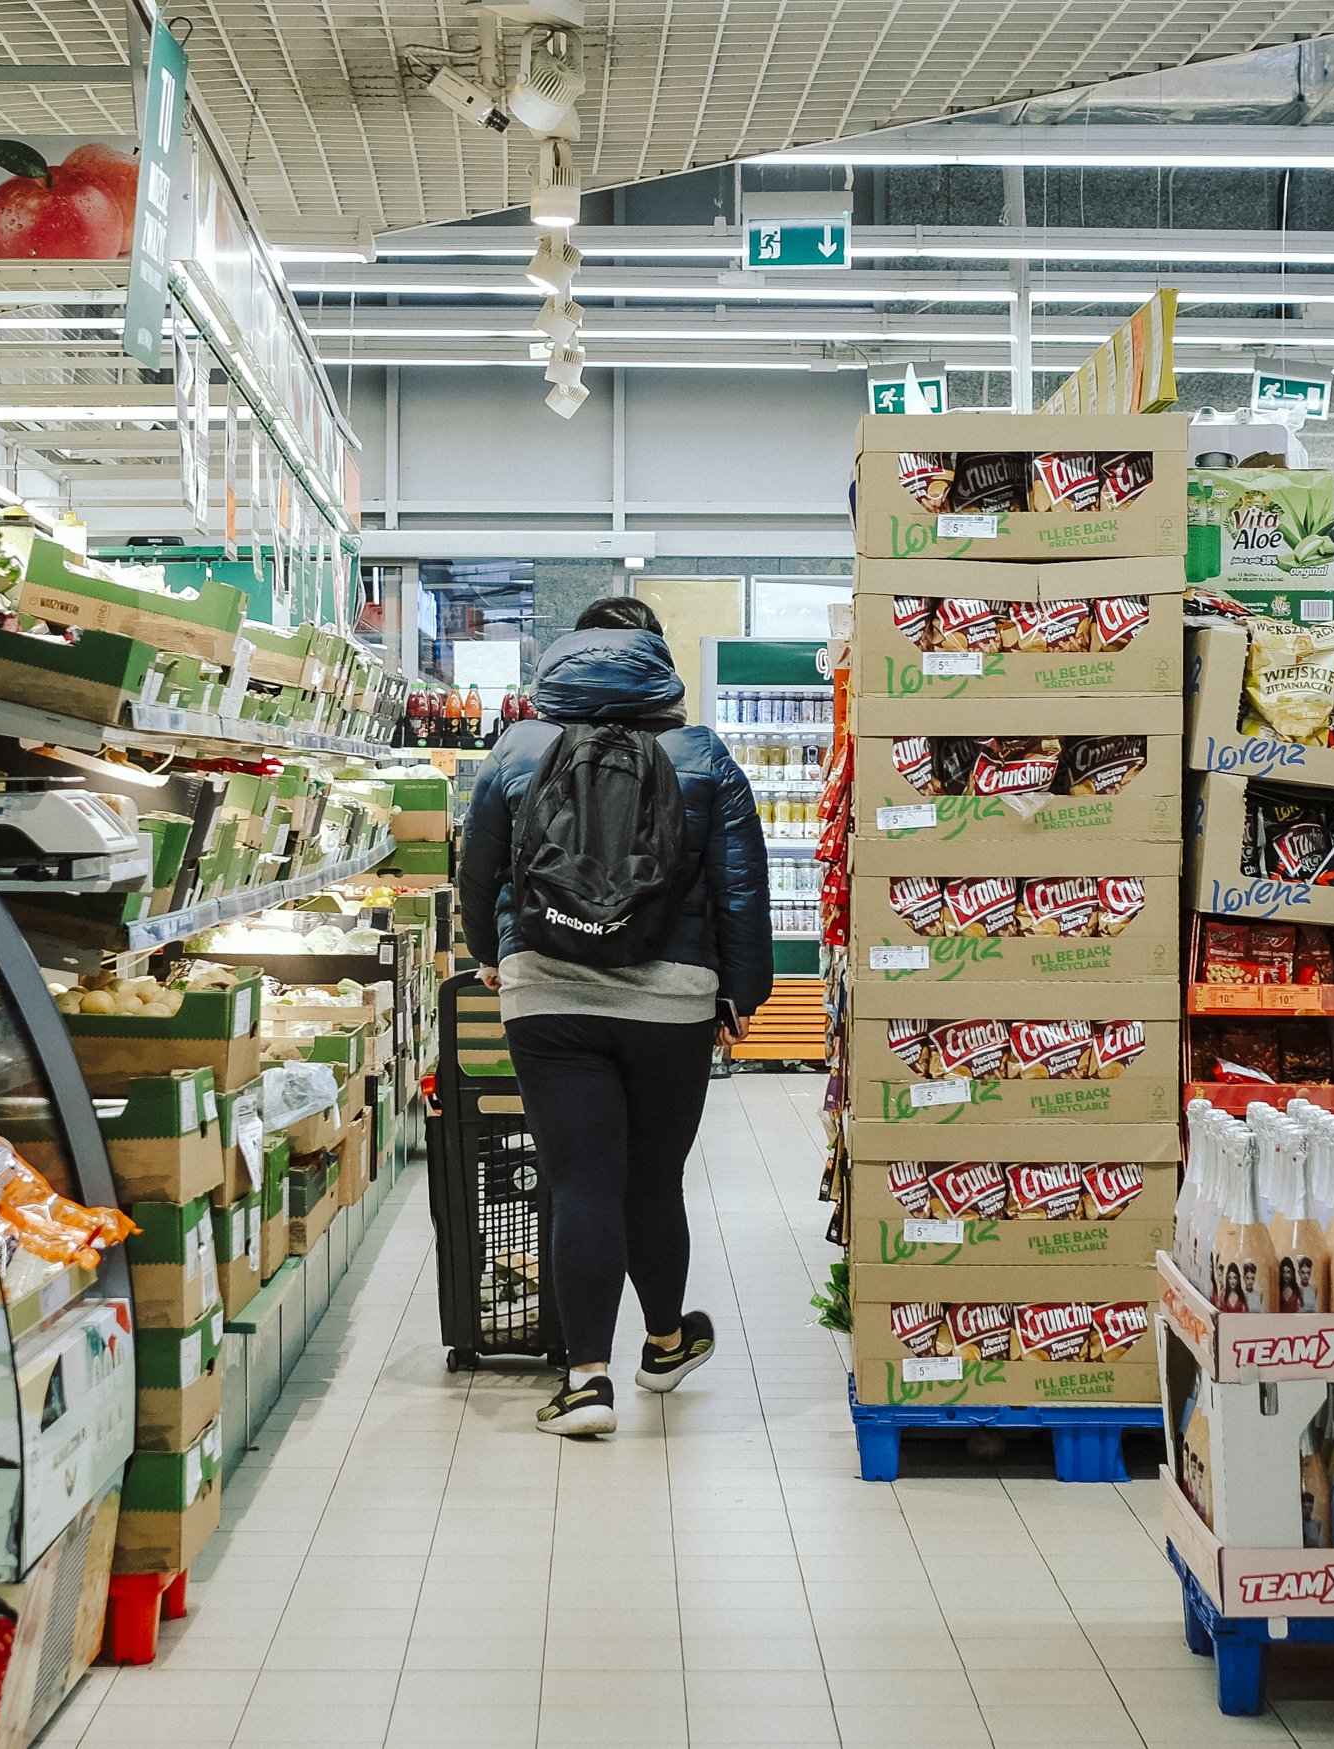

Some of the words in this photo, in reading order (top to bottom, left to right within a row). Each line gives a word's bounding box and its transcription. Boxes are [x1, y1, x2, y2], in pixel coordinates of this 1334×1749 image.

[158, 67, 175, 154] TU
[1233, 508, 1280, 530] Vita
[1039, 527, 1061, 542] I'LL
[1063, 525, 1083, 538] BE
[1084, 519, 1119, 535] BACK
[1049, 533, 1117, 548] #RECYCLABLE
[1233, 529, 1283, 550] Aloe
[1290, 565, 1329, 578] original
[1035, 669, 1057, 683] I'LL
[1059, 667, 1077, 679] BE
[1079, 661, 1115, 676] BACK
[1044, 676, 1113, 689] #RECYCLABLE
[1266, 681, 1332, 694] ZIEMNIACZKI
[1206, 736, 1306, 777] Lorenz
[977, 763, 1055, 794] Crunchips
[1034, 811, 1056, 825] I'LL
[1059, 809, 1077, 821] BE
[1078, 802, 1113, 818] BACK
[1043, 816, 1113, 830] #RECYCLABLE
[1212, 878, 1312, 919] Lorenz
[545, 907, 603, 935] Reebok
[1031, 954, 1053, 967] I'LL
[1056, 952, 1073, 963] BE
[1075, 945, 1111, 960] BACK
[1041, 959, 1111, 973] #RECYCLABLE
[1030, 1095, 1053, 1108] I'LL
[1055, 1093, 1073, 1104] BE
[1075, 1087, 1111, 1101] BACK
[1040, 1100, 1110, 1115] #RECYCLABLE
[1028, 1236, 1050, 1249] I'LL
[1052, 1233, 1070, 1245] BE
[1072, 1227, 1108, 1241] BACK
[1038, 1241, 1107, 1256] #RECYCLABLE
[1035, 1378, 1057, 1390] I'LL
[1059, 1375, 1077, 1387] BE
[1079, 1370, 1115, 1384] BACK
[1044, 1384, 1113, 1398] #RECYCLABLE
